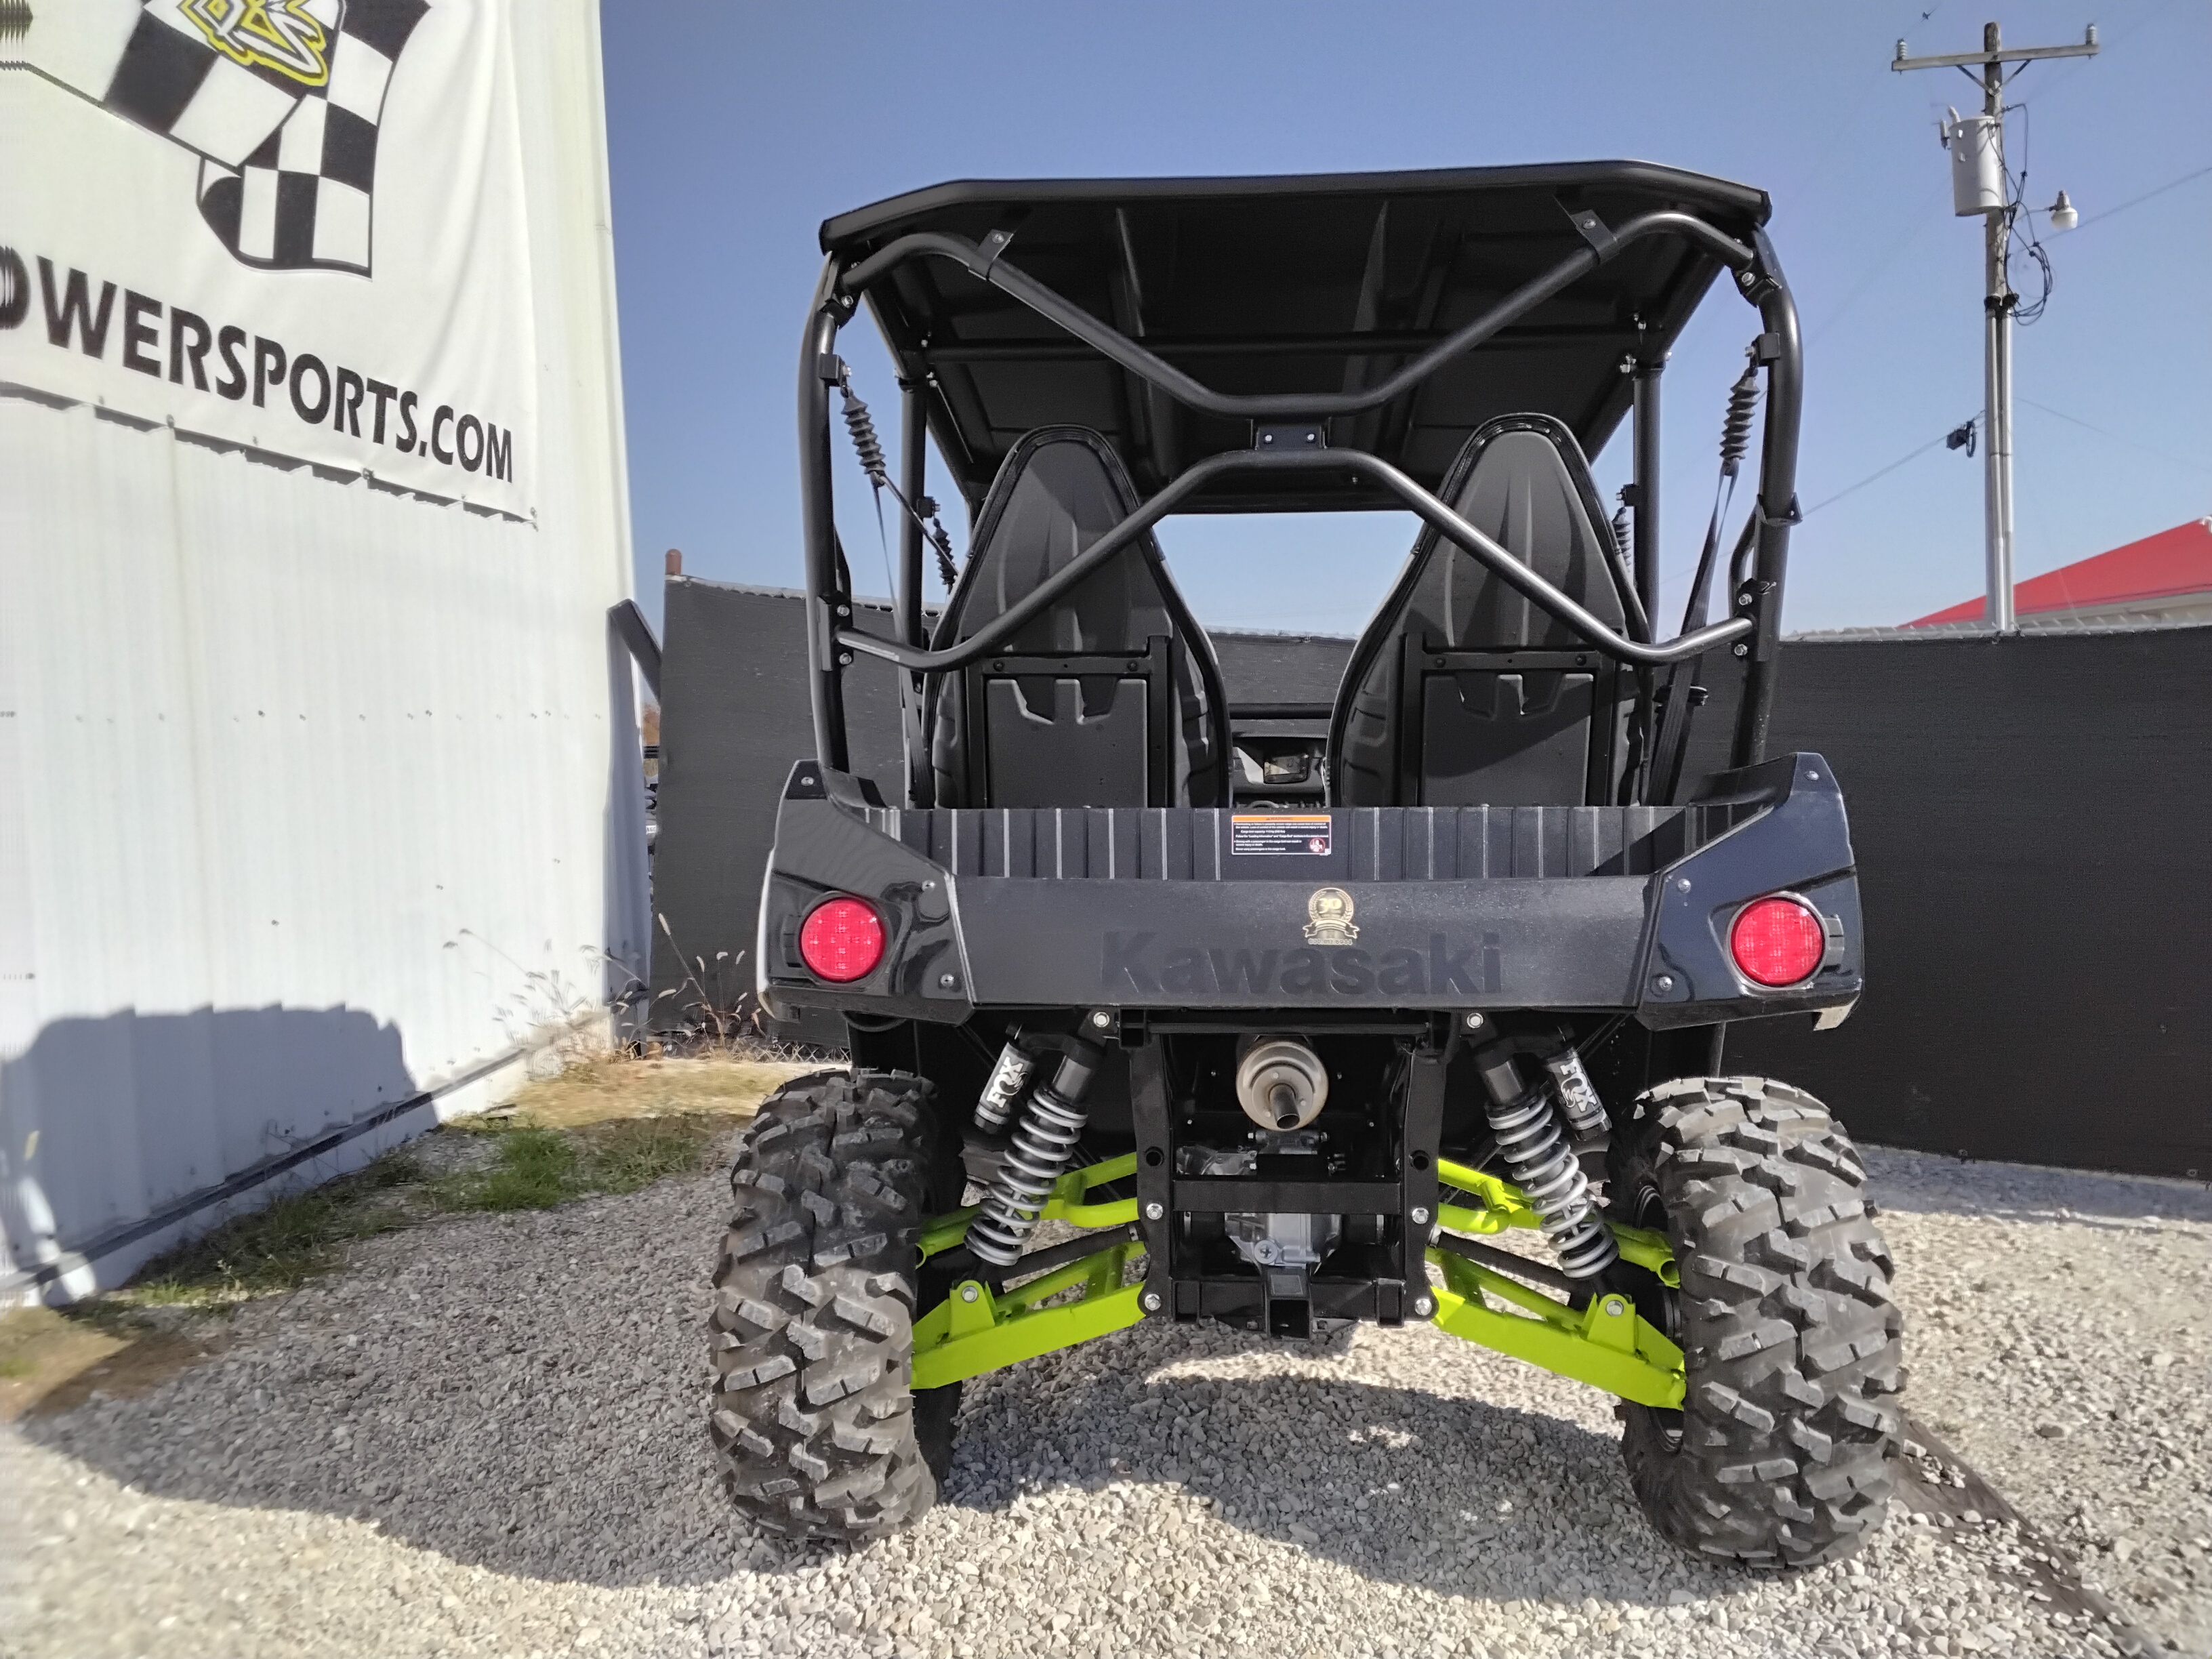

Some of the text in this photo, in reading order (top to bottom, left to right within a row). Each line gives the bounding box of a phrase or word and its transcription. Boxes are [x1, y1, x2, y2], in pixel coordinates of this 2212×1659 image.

[1101, 931, 1501, 996] Kawasaki
[986, 1056, 1027, 1108] FOX
[1560, 1057, 1597, 1112] FOX
